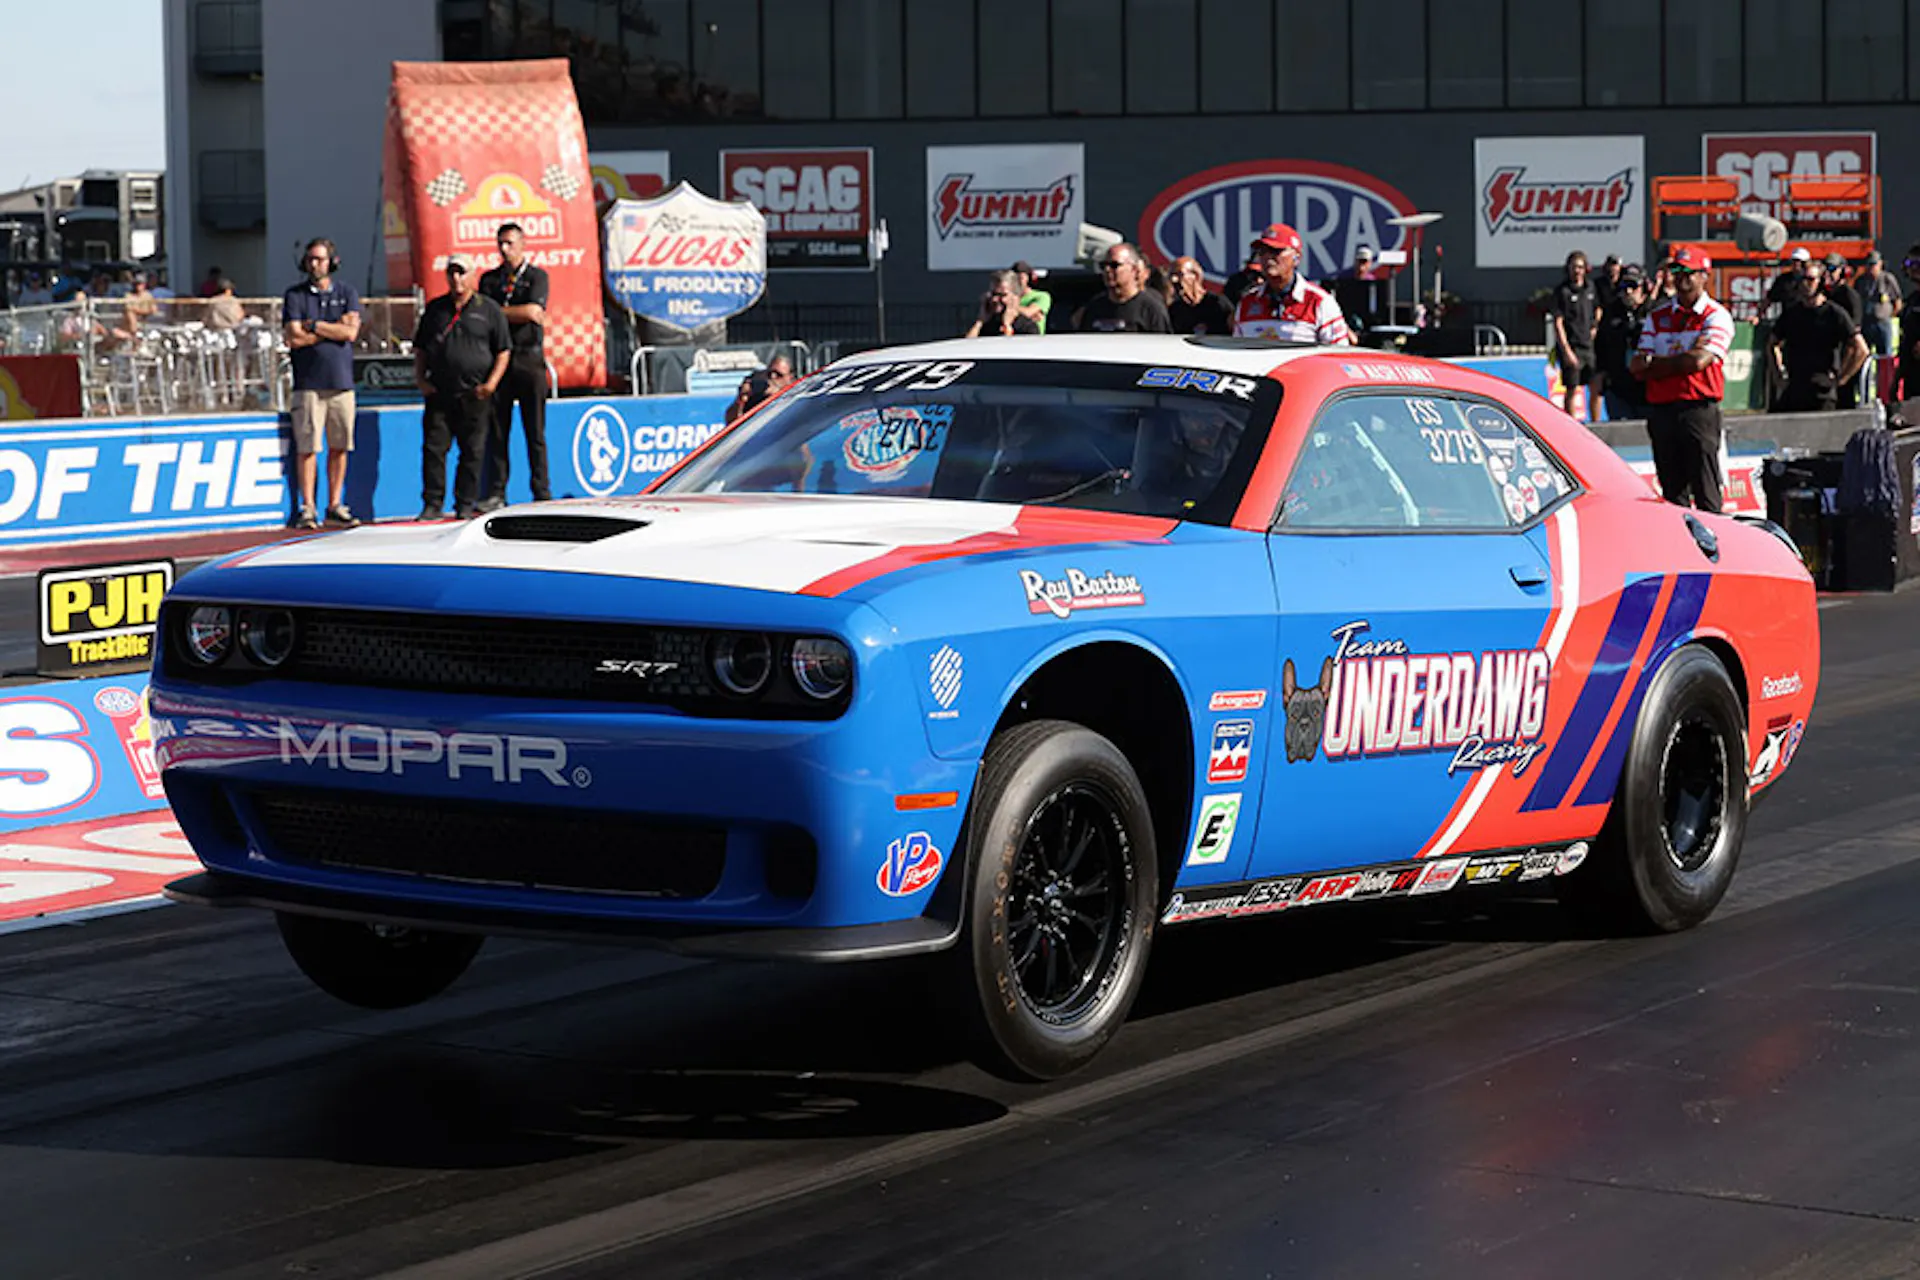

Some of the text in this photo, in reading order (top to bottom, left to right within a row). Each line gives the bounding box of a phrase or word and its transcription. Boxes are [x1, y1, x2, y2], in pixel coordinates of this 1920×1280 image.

[732, 165, 860, 212] SCAG
[625, 235, 750, 267] LUCAS
[1182, 184, 1382, 276] NHRA
[615, 276, 755, 294] OIL PRODUCTS
[668, 299, 707, 315] INC.
[1405, 399, 1443, 425] FSS
[1420, 427, 1484, 464] 3279
[122, 437, 290, 514] THE
[51, 572, 164, 633] PJH
[1018, 567, 1142, 618] Ray Barton
[68, 634, 150, 664] TrackBite
[1331, 619, 1407, 668] Team
[596, 660, 678, 678] SRT
[1322, 648, 1551, 760] UNDERDAWG
[279, 716, 570, 786] MOPAR
[1446, 734, 1546, 777] Racing
[888, 833, 932, 893] VP
[1298, 876, 1362, 903] ARP
